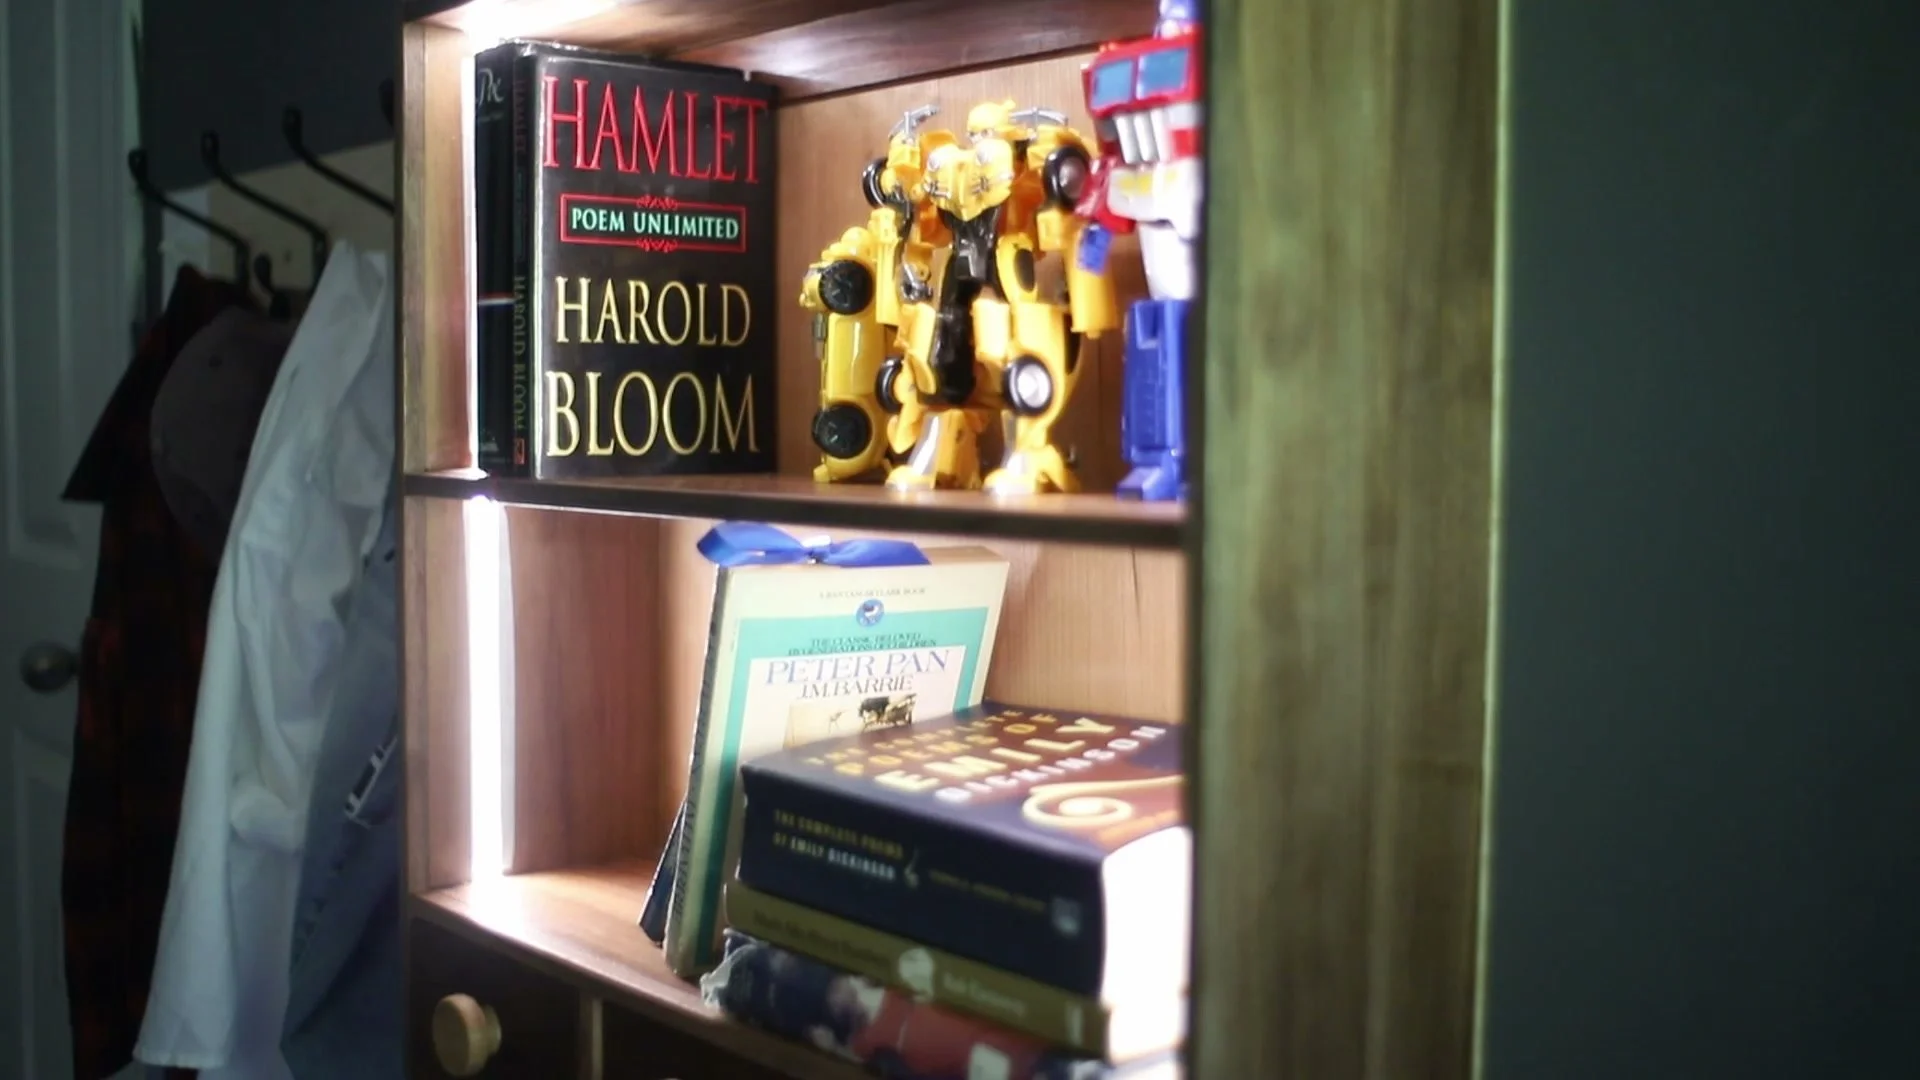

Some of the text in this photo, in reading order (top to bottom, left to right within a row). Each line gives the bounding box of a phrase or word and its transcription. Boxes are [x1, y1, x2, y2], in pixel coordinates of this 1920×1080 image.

[543, 75, 769, 184] HAMLET
[571, 207, 740, 240] POEM UNLIMITED
[514, 275, 526, 356] HAROLD
[554, 275, 751, 348] HAROLD
[513, 361, 527, 431] BLOOM
[546, 369, 760, 458] BLOOM
[765, 649, 950, 685] PETER PAN
[833, 674, 914, 697] BARRIE
[833, 712, 1058, 777] POEMS OF
[873, 715, 1117, 793] EMILY
[933, 723, 1168, 802] DICKINSON
